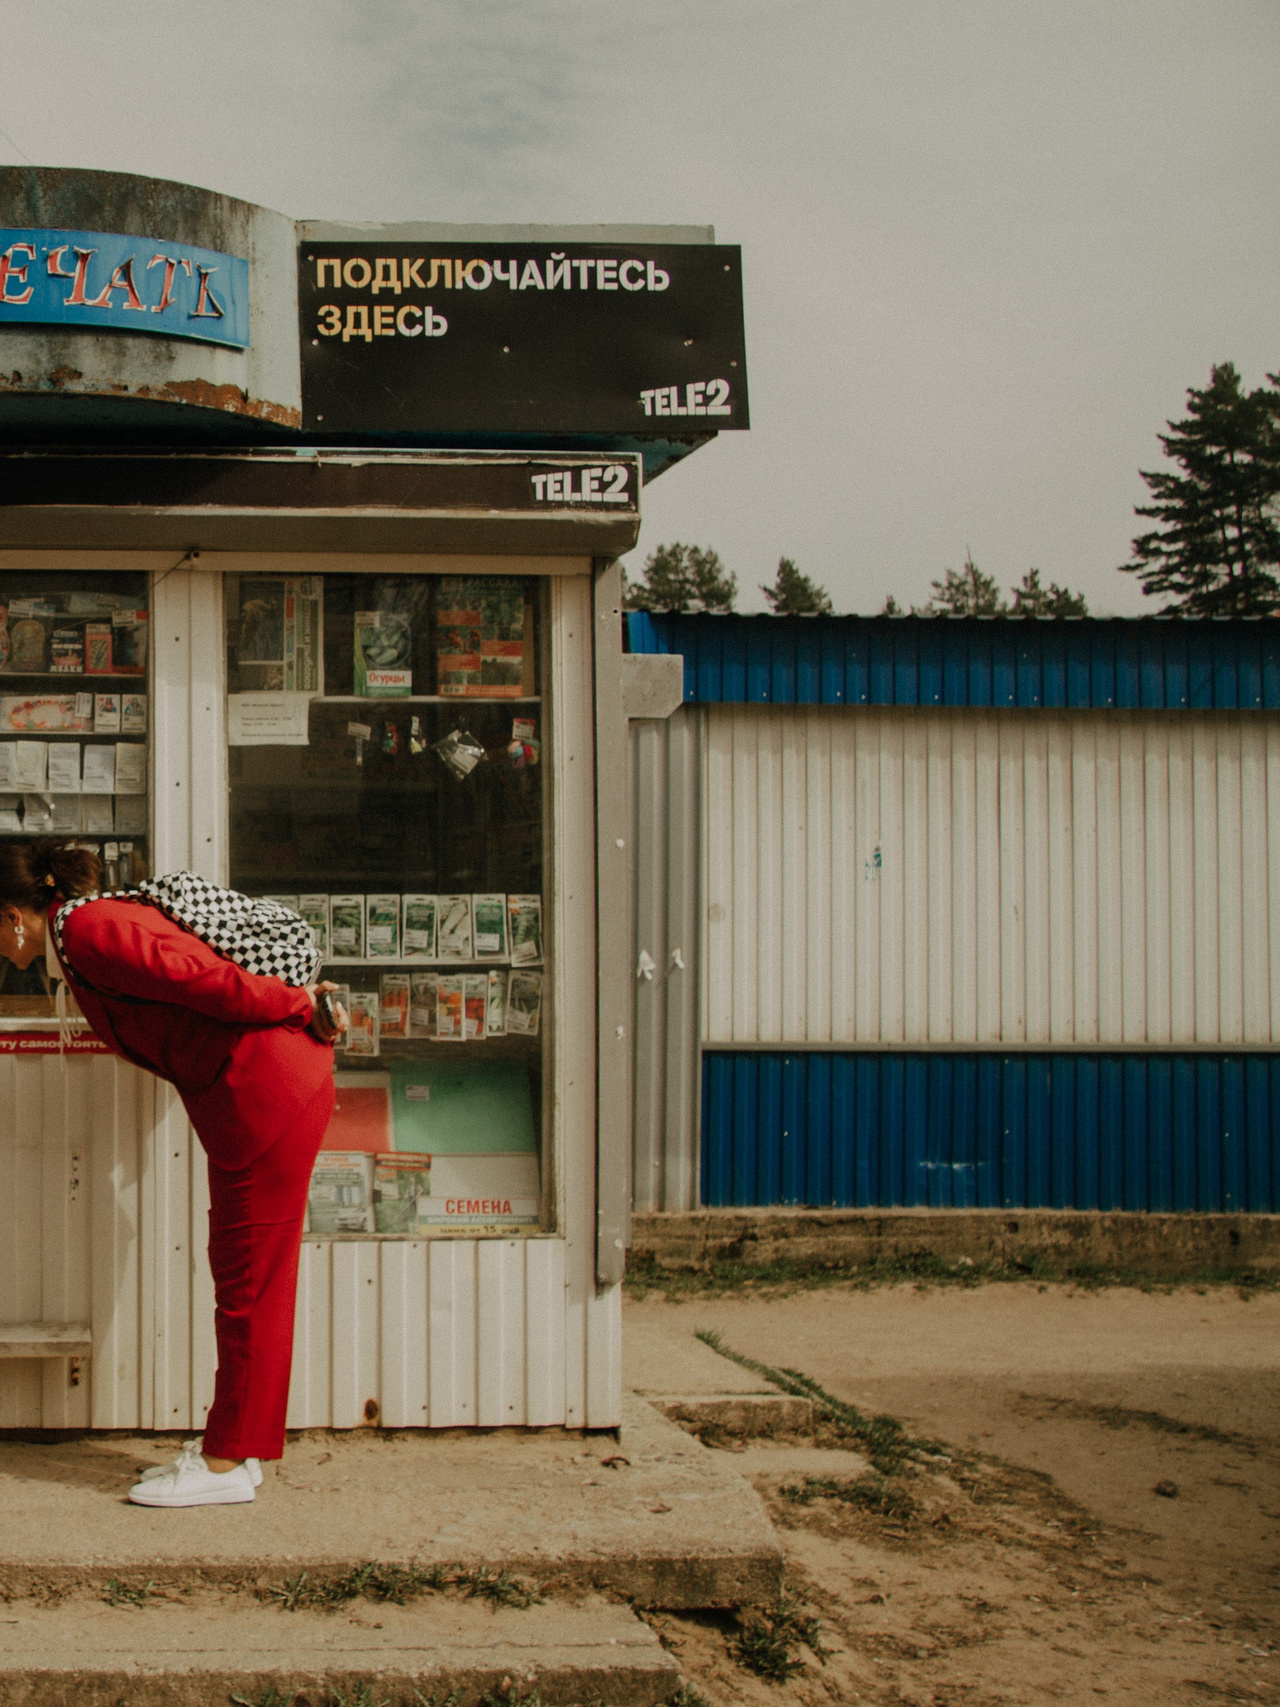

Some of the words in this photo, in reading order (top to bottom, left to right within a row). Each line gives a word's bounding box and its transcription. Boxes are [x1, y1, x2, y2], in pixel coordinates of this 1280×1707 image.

[316, 252, 671, 295] ПОДКЛЮЧАЙТЕСЬ
[316, 305, 449, 342] ЗДЕСЬ
[640, 378, 732, 416] TELE2
[531, 465, 629, 503] TELE2
[369, 672, 406, 684] Огурцы
[445, 1199, 512, 1214] СЕМЕНА
